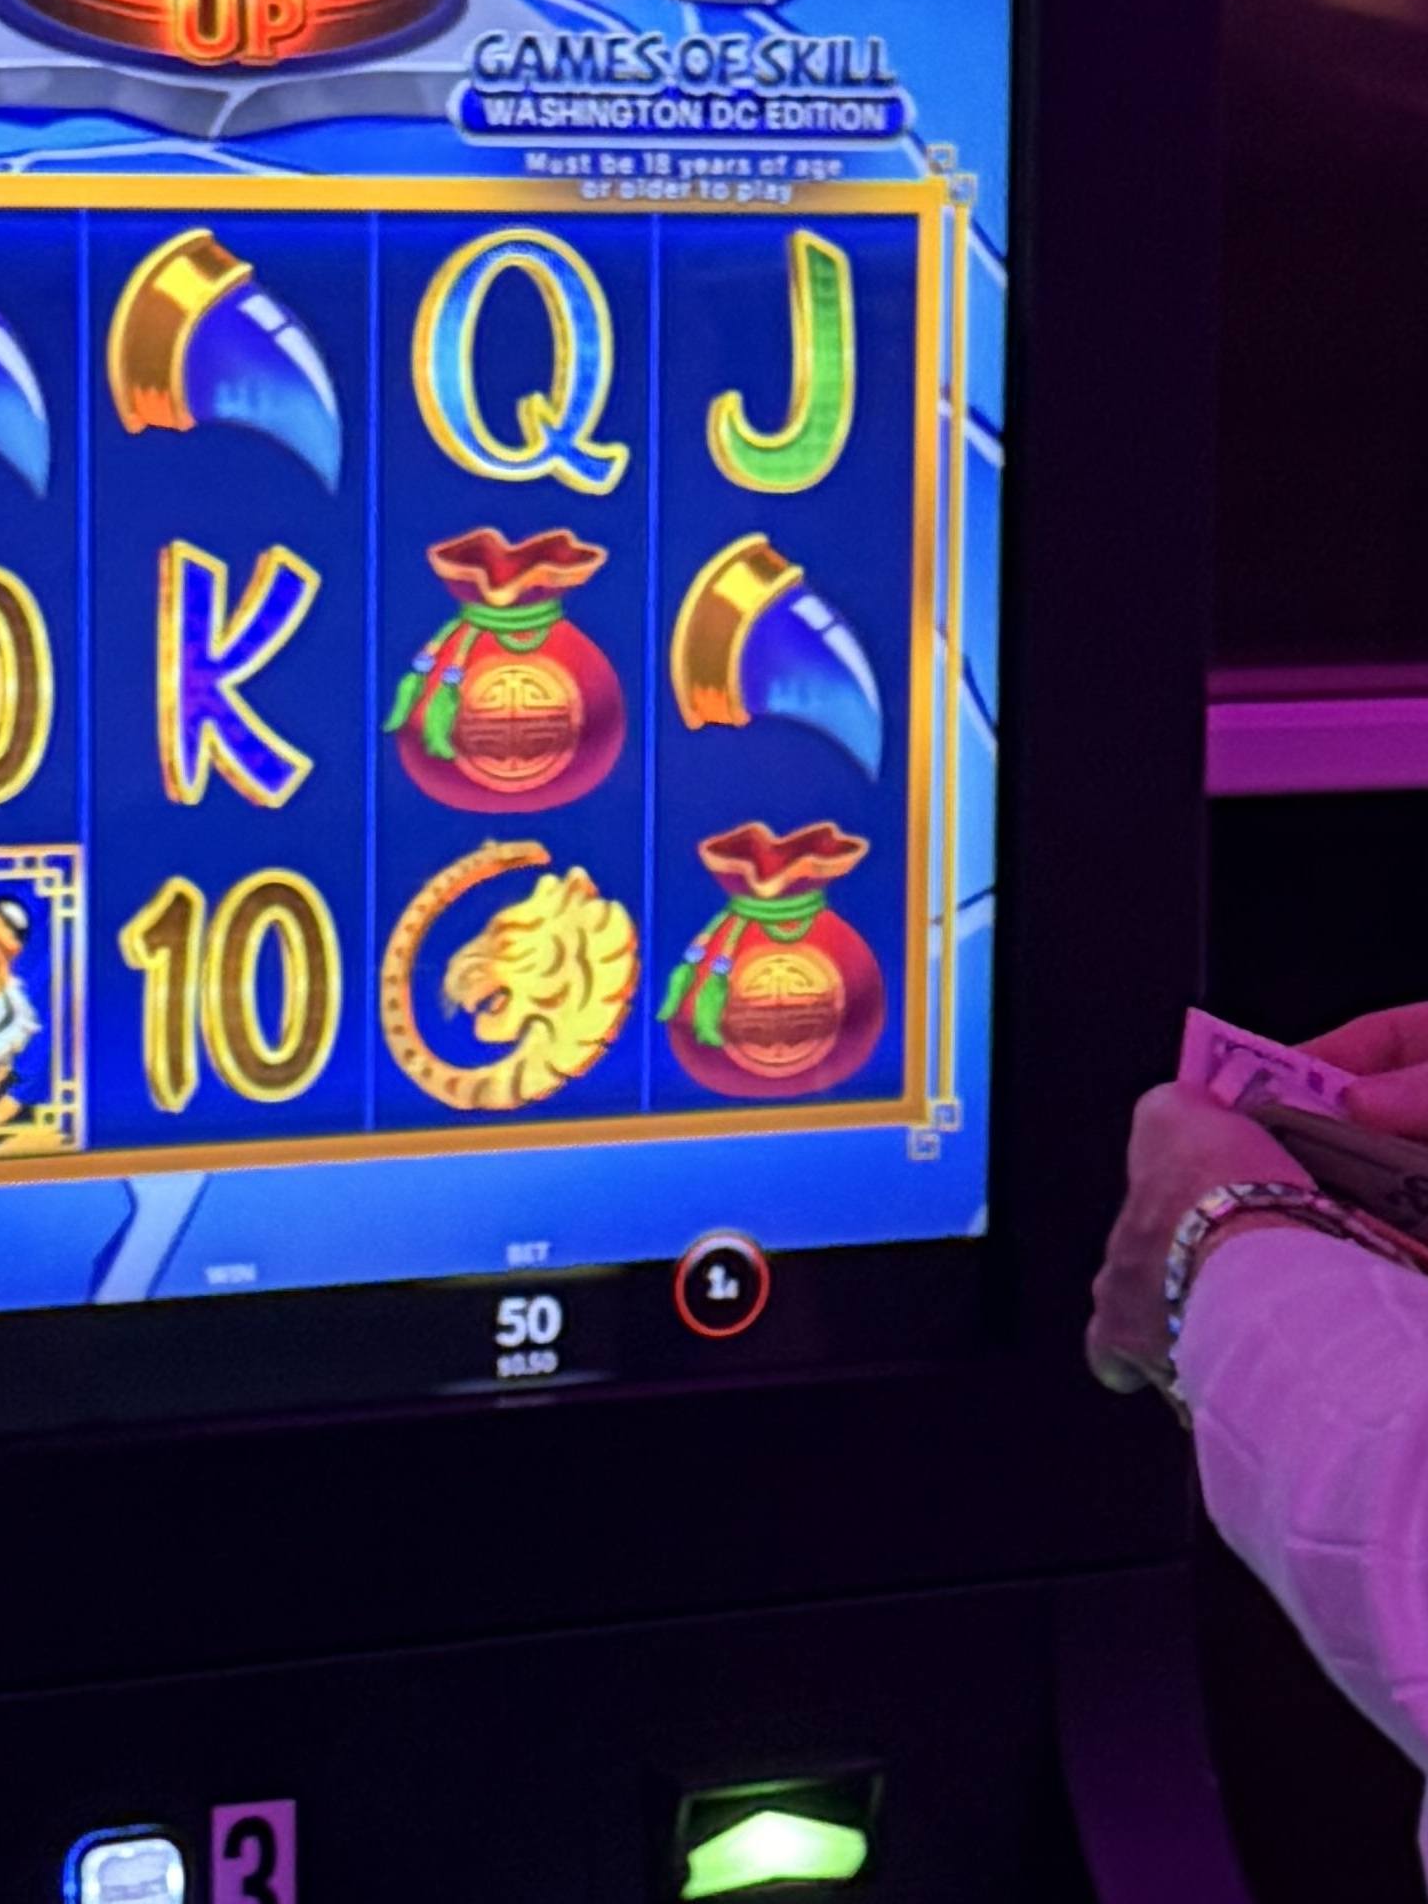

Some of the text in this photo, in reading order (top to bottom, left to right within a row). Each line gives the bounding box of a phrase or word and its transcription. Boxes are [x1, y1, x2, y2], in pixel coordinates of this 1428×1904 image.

[473, 32, 899, 88] GAMES OF SKILL
[484, 96, 887, 132] WASHINGTON DC EDITION
[524, 152, 592, 175] Must
[599, 152, 635, 175] be
[678, 156, 752, 180] years
[759, 155, 789, 177] of
[794, 158, 843, 181] age
[580, 178, 793, 205] or older to play
[412, 227, 630, 496] Q
[707, 228, 856, 495] J
[156, 538, 322, 809] K
[118, 865, 343, 1115] 10
[495, 1293, 563, 1348] 50
